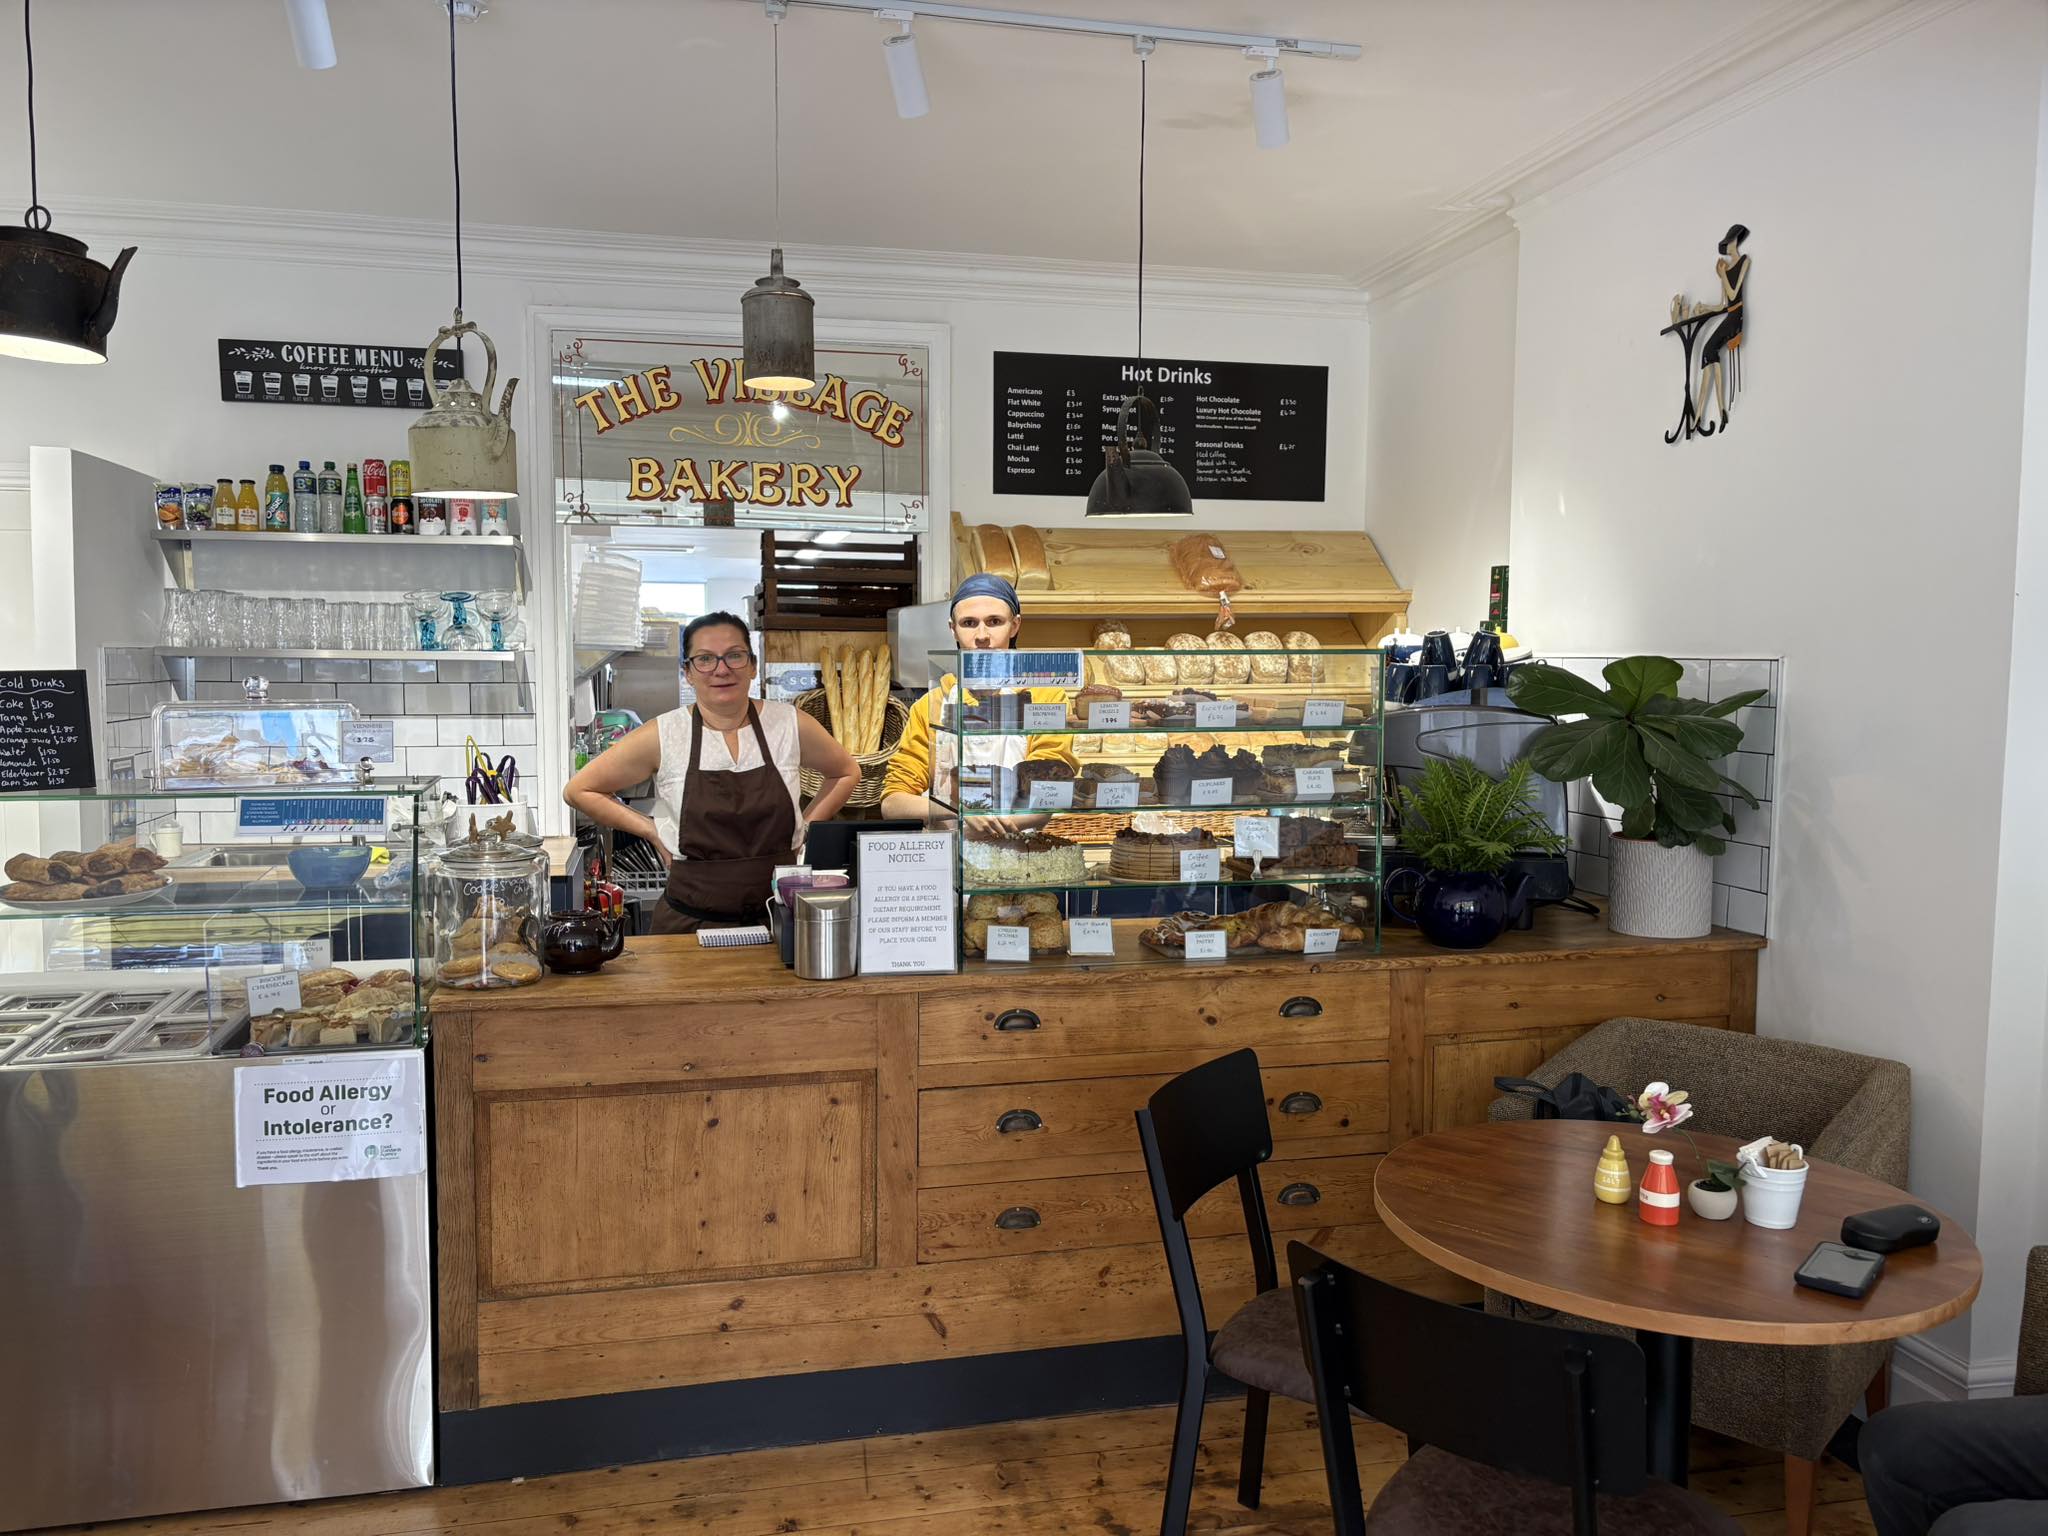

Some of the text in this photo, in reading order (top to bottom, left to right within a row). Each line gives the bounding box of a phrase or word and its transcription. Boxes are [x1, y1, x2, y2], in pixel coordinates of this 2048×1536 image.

[281, 344, 404, 367] COFFEE MENU
[360, 366, 392, 374] coffee
[1121, 366, 1212, 384] Hot Drinks
[574, 366, 682, 434] THE
[1008, 410, 1044, 418] Cappuccino
[1196, 406, 1217, 414] Luxury
[627, 457, 861, 507] BAKERY
[0, 676, 65, 689] Cold Drinks
[0, 697, 54, 710] Coke £1.50
[0, 711, 55, 726] Tango £1.50
[0, 726, 22, 735] Apple
[0, 746, 57, 757] Water £1.50
[41, 757, 60, 765] £1.50
[1, 768, 45, 778] Elderflower
[868, 841, 945, 851] FOOD ALLERGY
[888, 853, 925, 863] NOTICE
[264, 1084, 392, 1104] Food Allergy
[320, 1104, 336, 1116] or
[264, 1113, 393, 1136] Intolerance?
[1602, 1176, 1620, 1184] SALT
